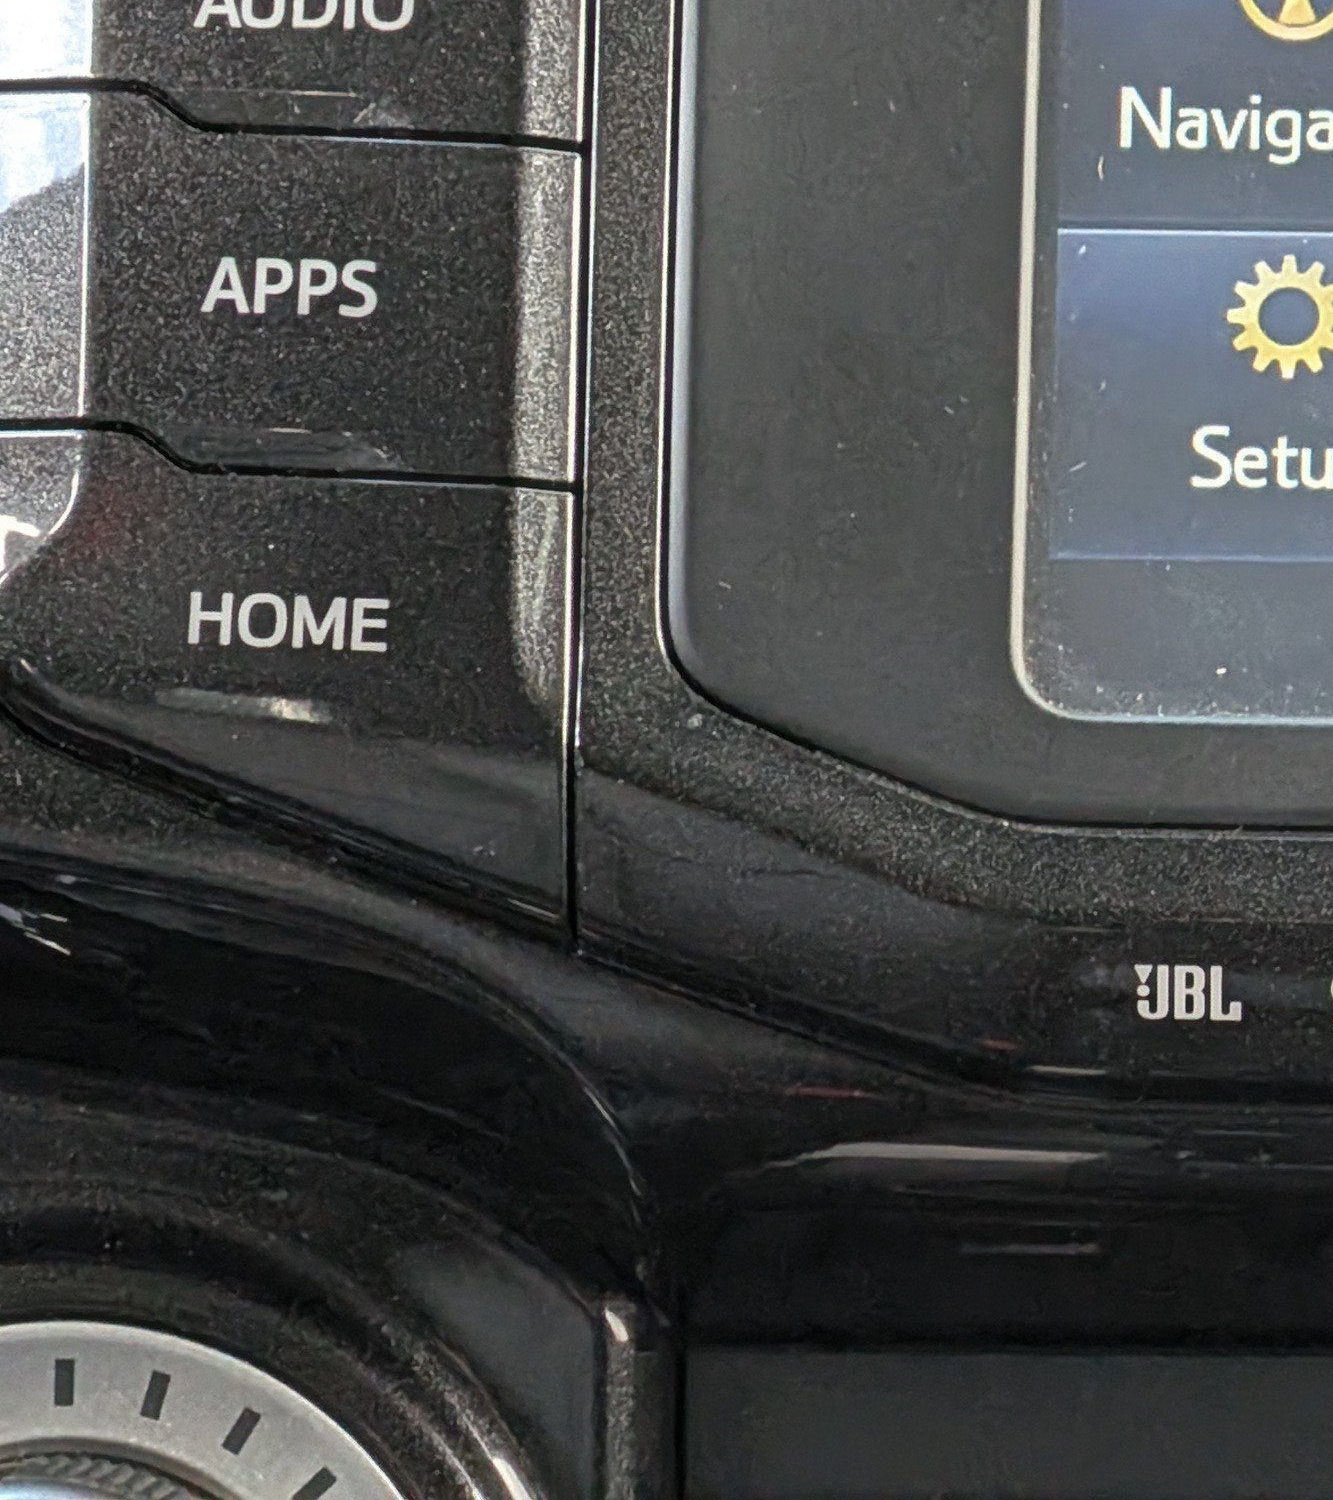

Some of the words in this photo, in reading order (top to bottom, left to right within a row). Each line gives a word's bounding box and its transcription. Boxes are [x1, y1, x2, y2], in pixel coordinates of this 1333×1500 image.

[200, 256, 378, 318] APPS
[187, 590, 390, 653] HOME
[1134, 963, 1243, 1022] JBL
